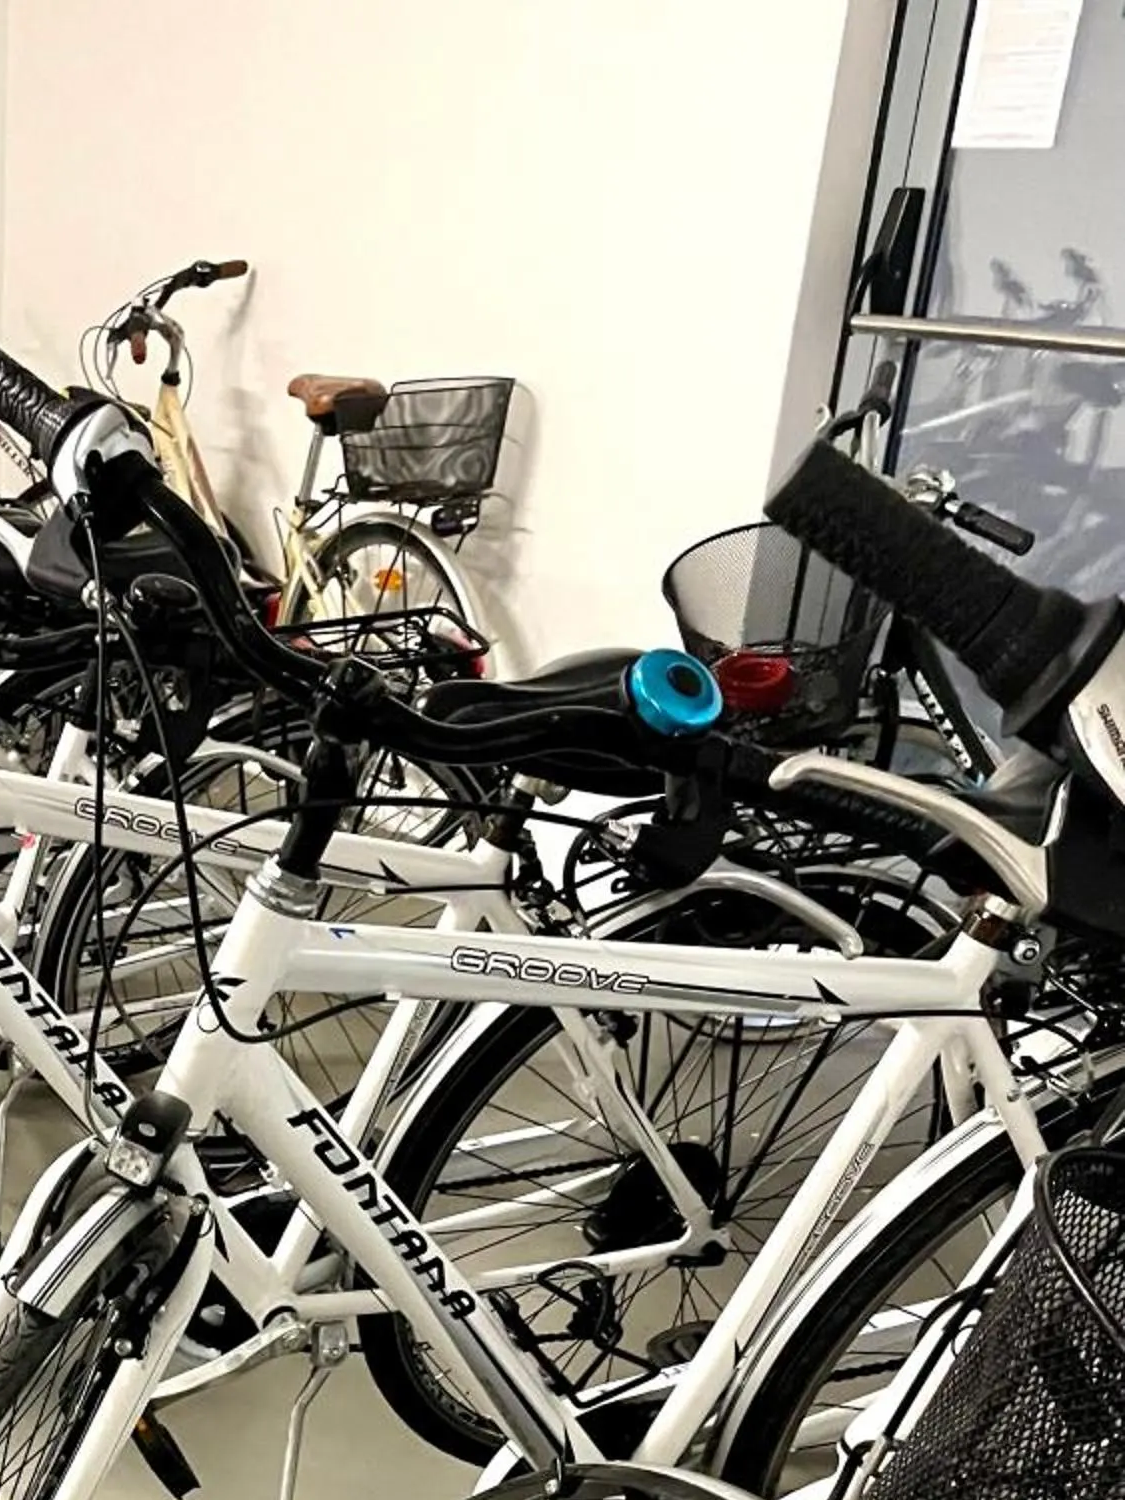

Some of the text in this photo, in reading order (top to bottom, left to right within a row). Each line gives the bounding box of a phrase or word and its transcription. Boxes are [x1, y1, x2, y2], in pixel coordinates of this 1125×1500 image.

[76, 797, 241, 856] GROOE
[451, 945, 650, 995] GROOVE
[286, 1107, 477, 1320] FONTANA
